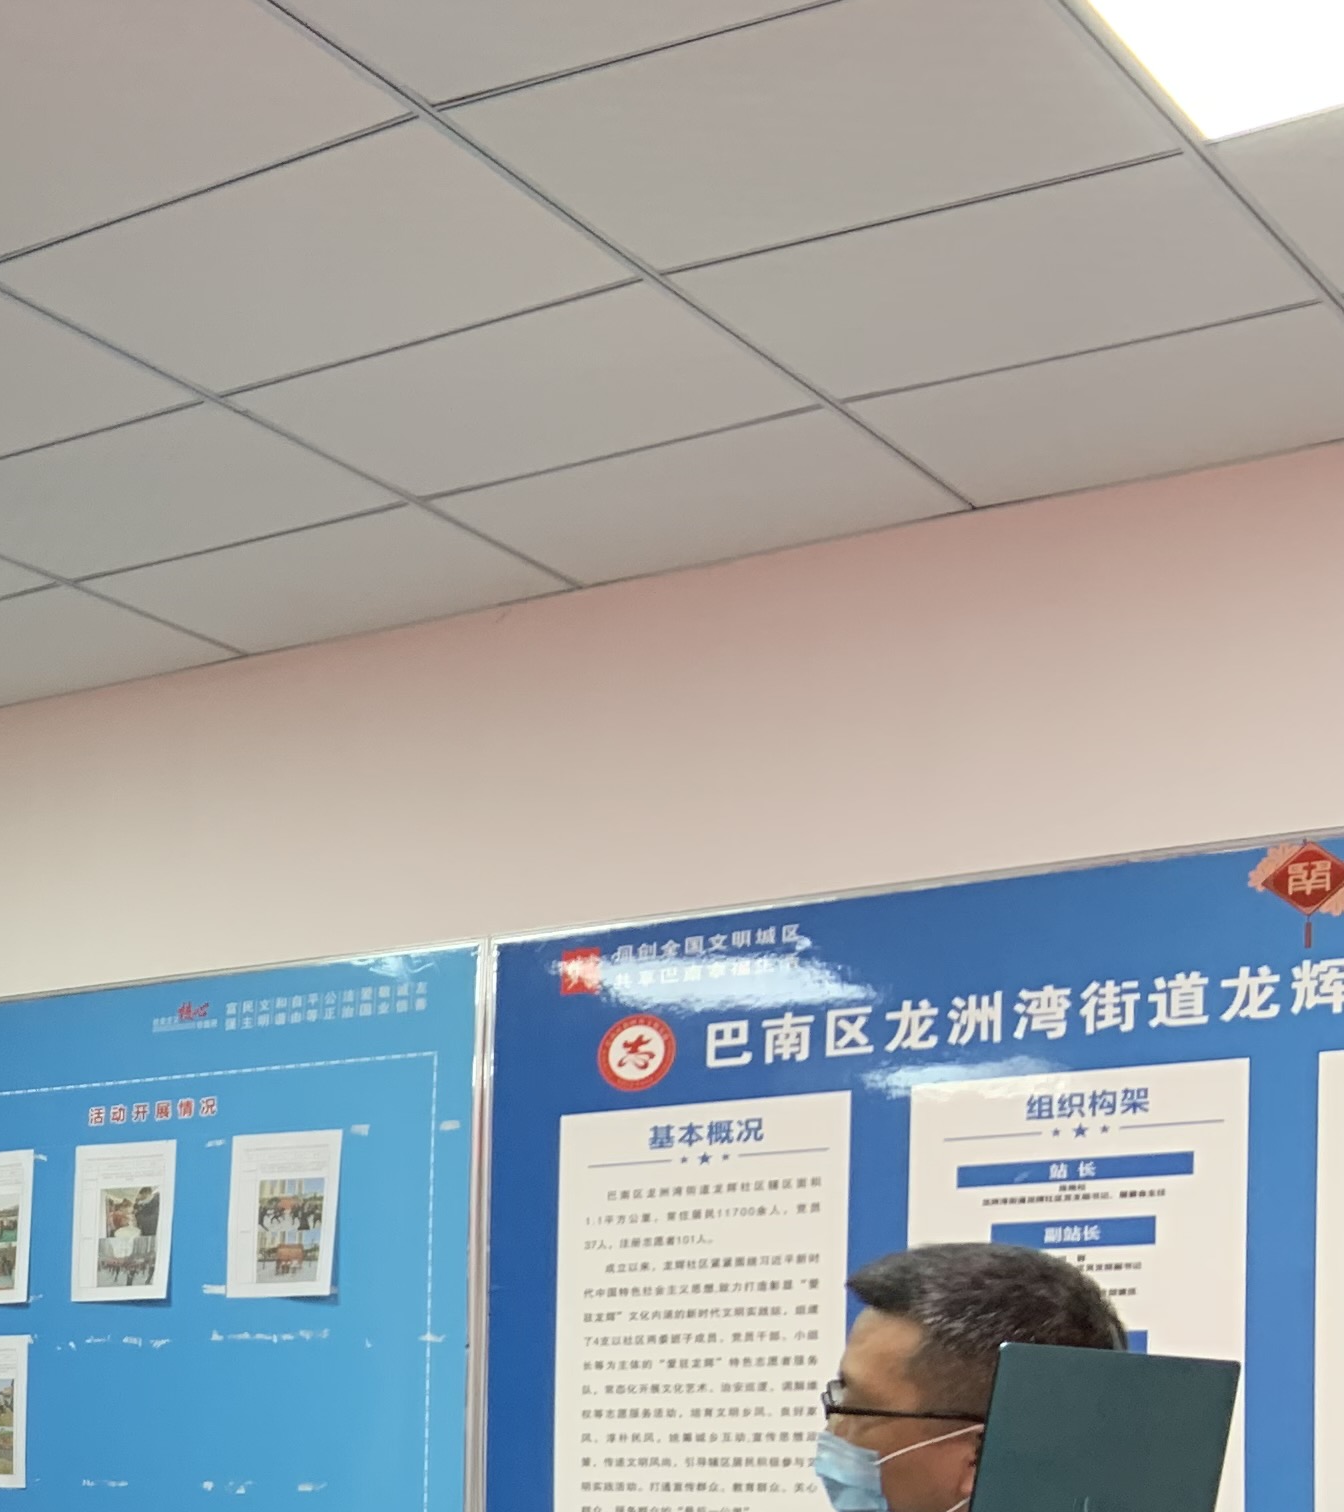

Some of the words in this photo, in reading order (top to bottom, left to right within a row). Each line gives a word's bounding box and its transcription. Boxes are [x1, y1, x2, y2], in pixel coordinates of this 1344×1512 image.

[705, 958, 1344, 1068] 巴南区龙洲湾街道龙辉
[88, 1096, 218, 1127] 活动开展情况
[1025, 1087, 1150, 1121] 组织构架
[649, 1117, 765, 1150] 基本概况
[1049, 1161, 1097, 1180] 站长
[1044, 1225, 1101, 1244] 副站长
